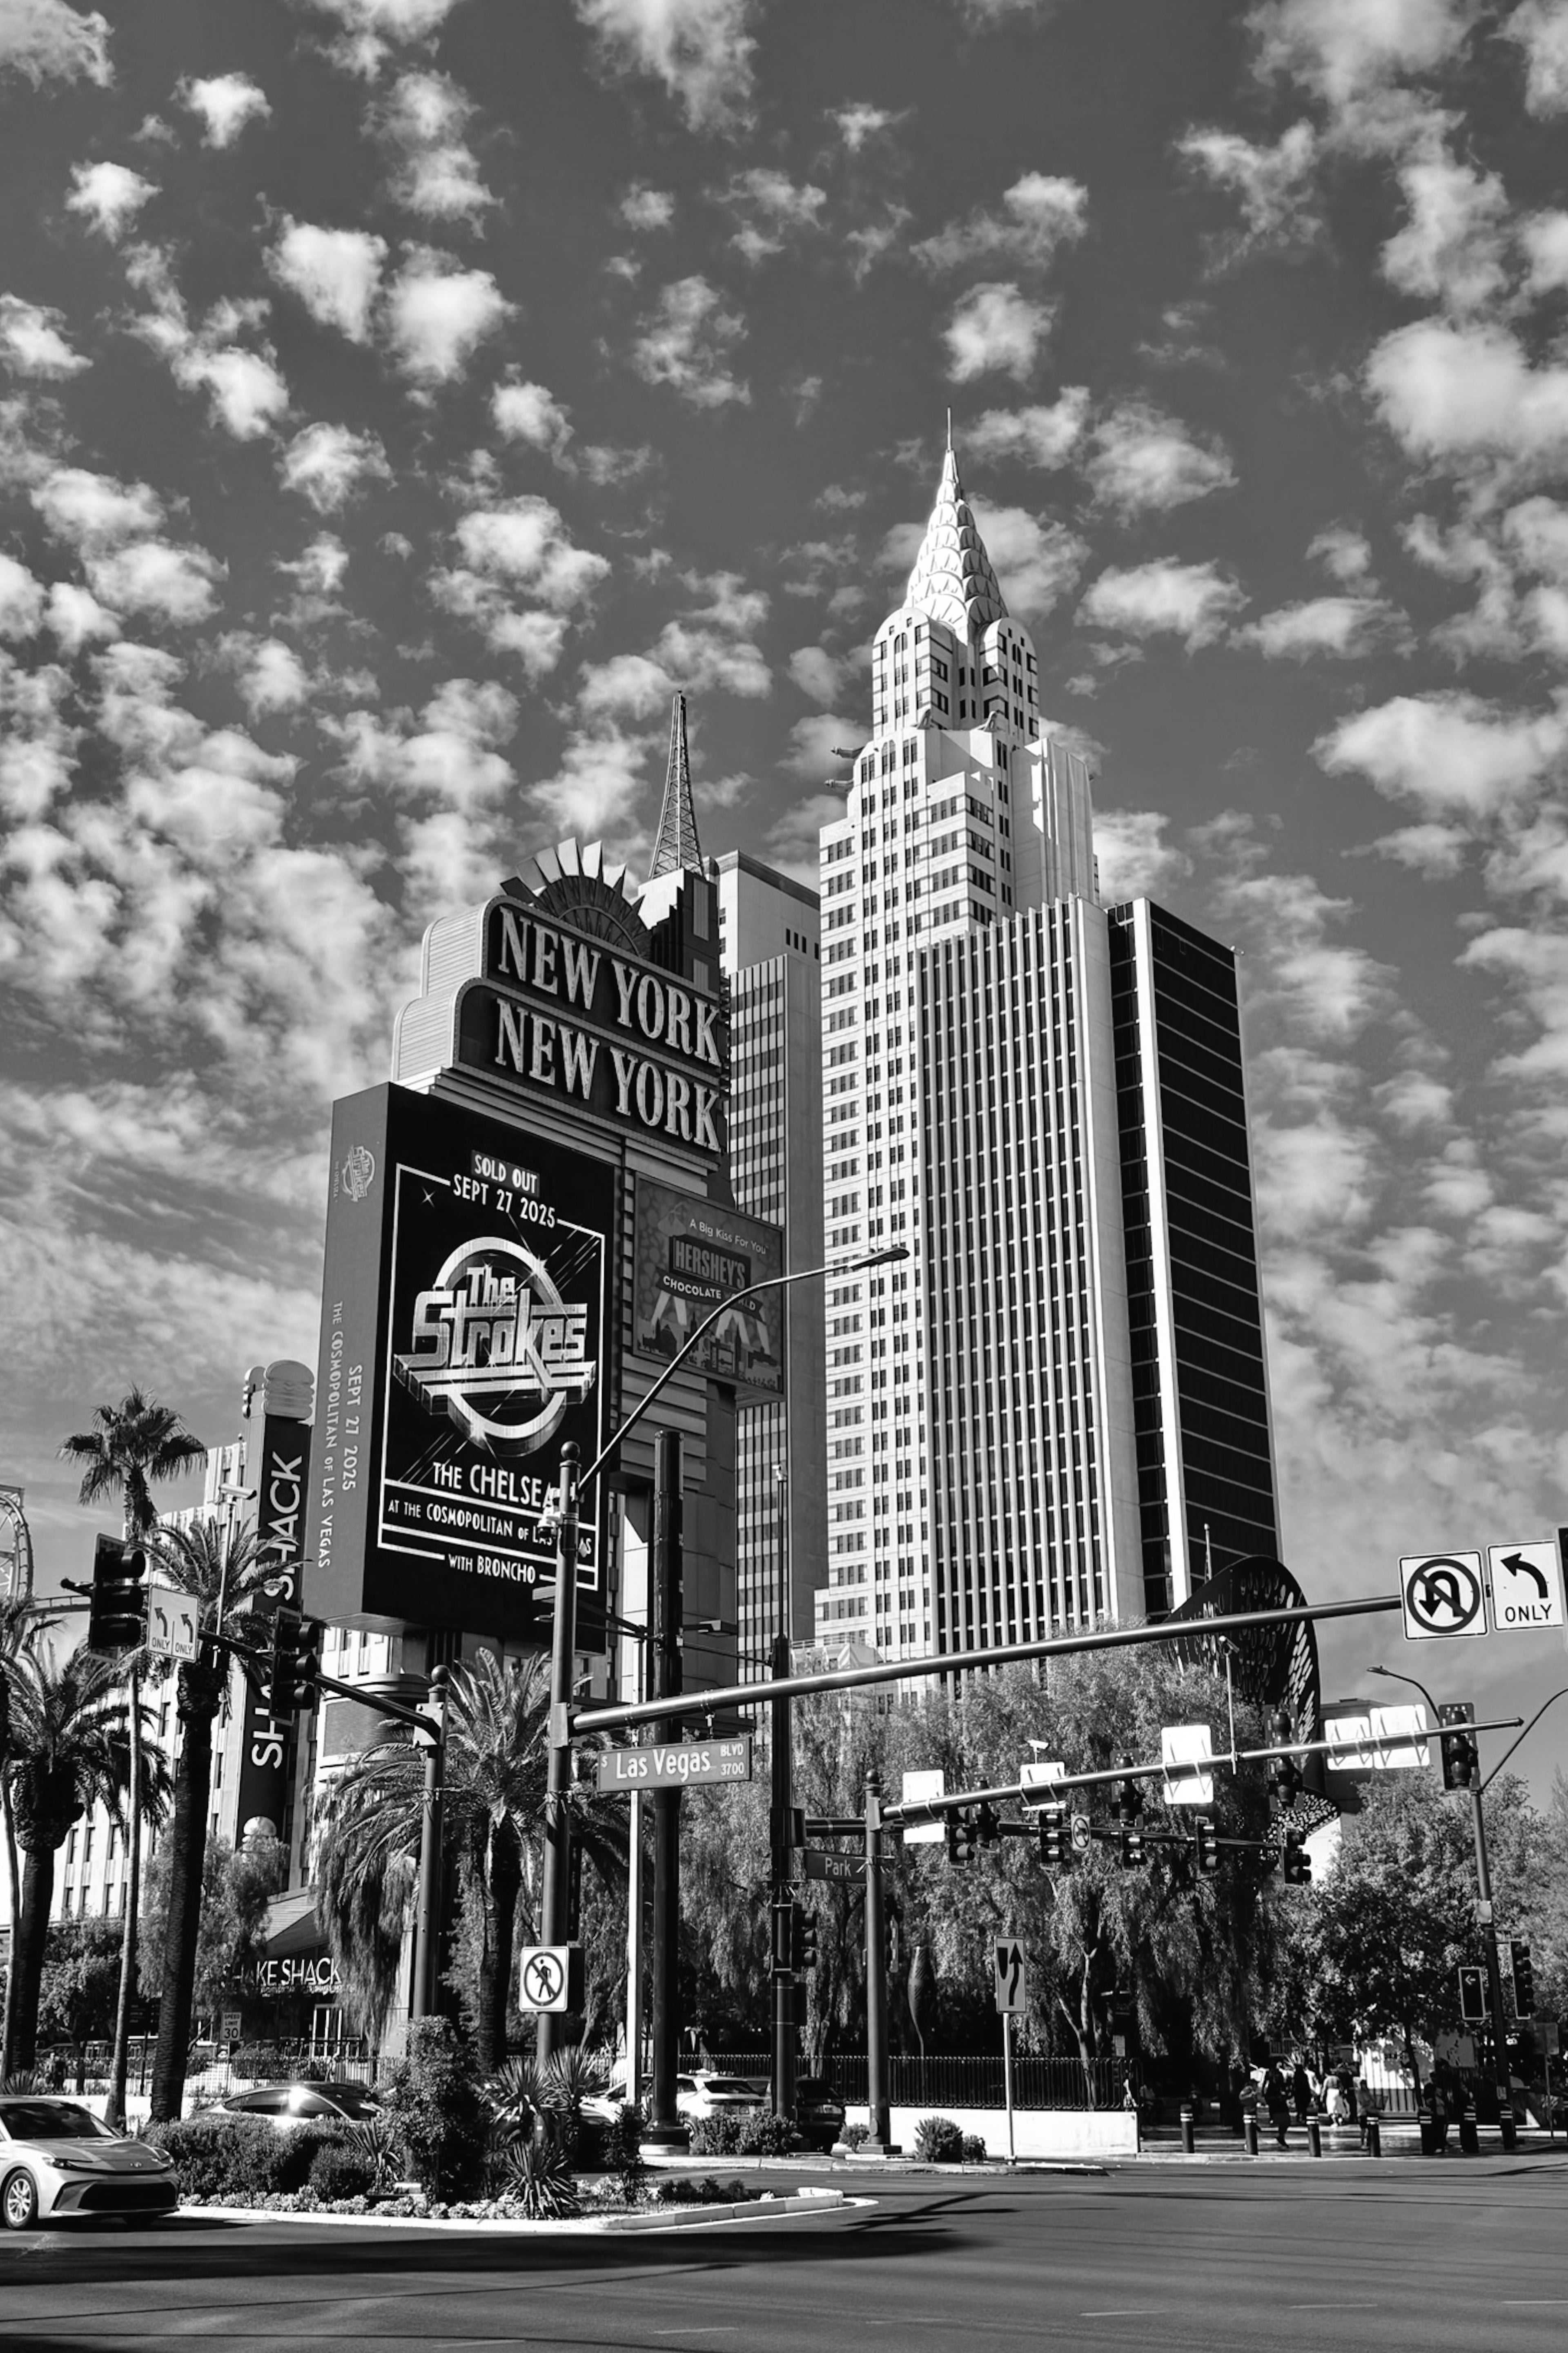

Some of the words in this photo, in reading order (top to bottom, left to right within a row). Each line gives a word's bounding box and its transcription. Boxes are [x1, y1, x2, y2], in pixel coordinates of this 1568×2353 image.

[497, 906, 601, 1010] NEW
[612, 959, 722, 1067] YORK
[494, 997, 600, 1100] NEW
[610, 1046, 721, 1153] YORK
[474, 1154, 506, 1182] SOLD
[512, 1169, 537, 1194] OUT
[453, 1174, 489, 1206] SEPT
[496, 1190, 512, 1213] 27
[520, 1198, 555, 1228] 2025
[689, 1219, 697, 1229] A
[699, 1222, 713, 1237] Big
[716, 1228, 733, 1242] Kiss
[735, 1235, 748, 1248] For
[675, 1239, 745, 1290] HERSHEY'S
[467, 1265, 516, 1307] The
[663, 1275, 722, 1300] CHOCOLATE
[332, 1301, 343, 1325] THE
[394, 1288, 588, 1368] Strokes
[325, 1331, 343, 1448] COSMOPOLITAN
[347, 1364, 363, 1405] SEPT
[345, 1415, 360, 1435] 27
[324, 1456, 333, 1471] OF
[342, 1446, 359, 1490] 2025
[321, 1476, 334, 1508] LAS
[433, 1462, 462, 1489] THE
[469, 1465, 555, 1508] CHELSEA
[263, 1451, 303, 1600] SHACK
[388, 1499, 402, 1512] AT
[404, 1503, 421, 1519] THE
[426, 1504, 513, 1537] COSMOPOLITAN
[518, 1528, 529, 1540] OF
[318, 1515, 333, 1568] VEGAS
[448, 1554, 473, 1572] WITH
[477, 1555, 536, 1584] BRONCHO
[1505, 1604, 1552, 1622] ONLY
[152, 1637, 170, 1650] ONLY
[175, 1642, 193, 1655] ONLY
[601, 1755, 608, 1768] S
[616, 1753, 648, 1779] Las
[653, 1749, 710, 1782] Vegas
[720, 1744, 744, 1757] BLVD
[721, 1762, 744, 1776] 3700
[825, 1857, 852, 1877] Park
[281, 1957, 342, 1986] SHACK
[224, 2028, 238, 2039] 30
